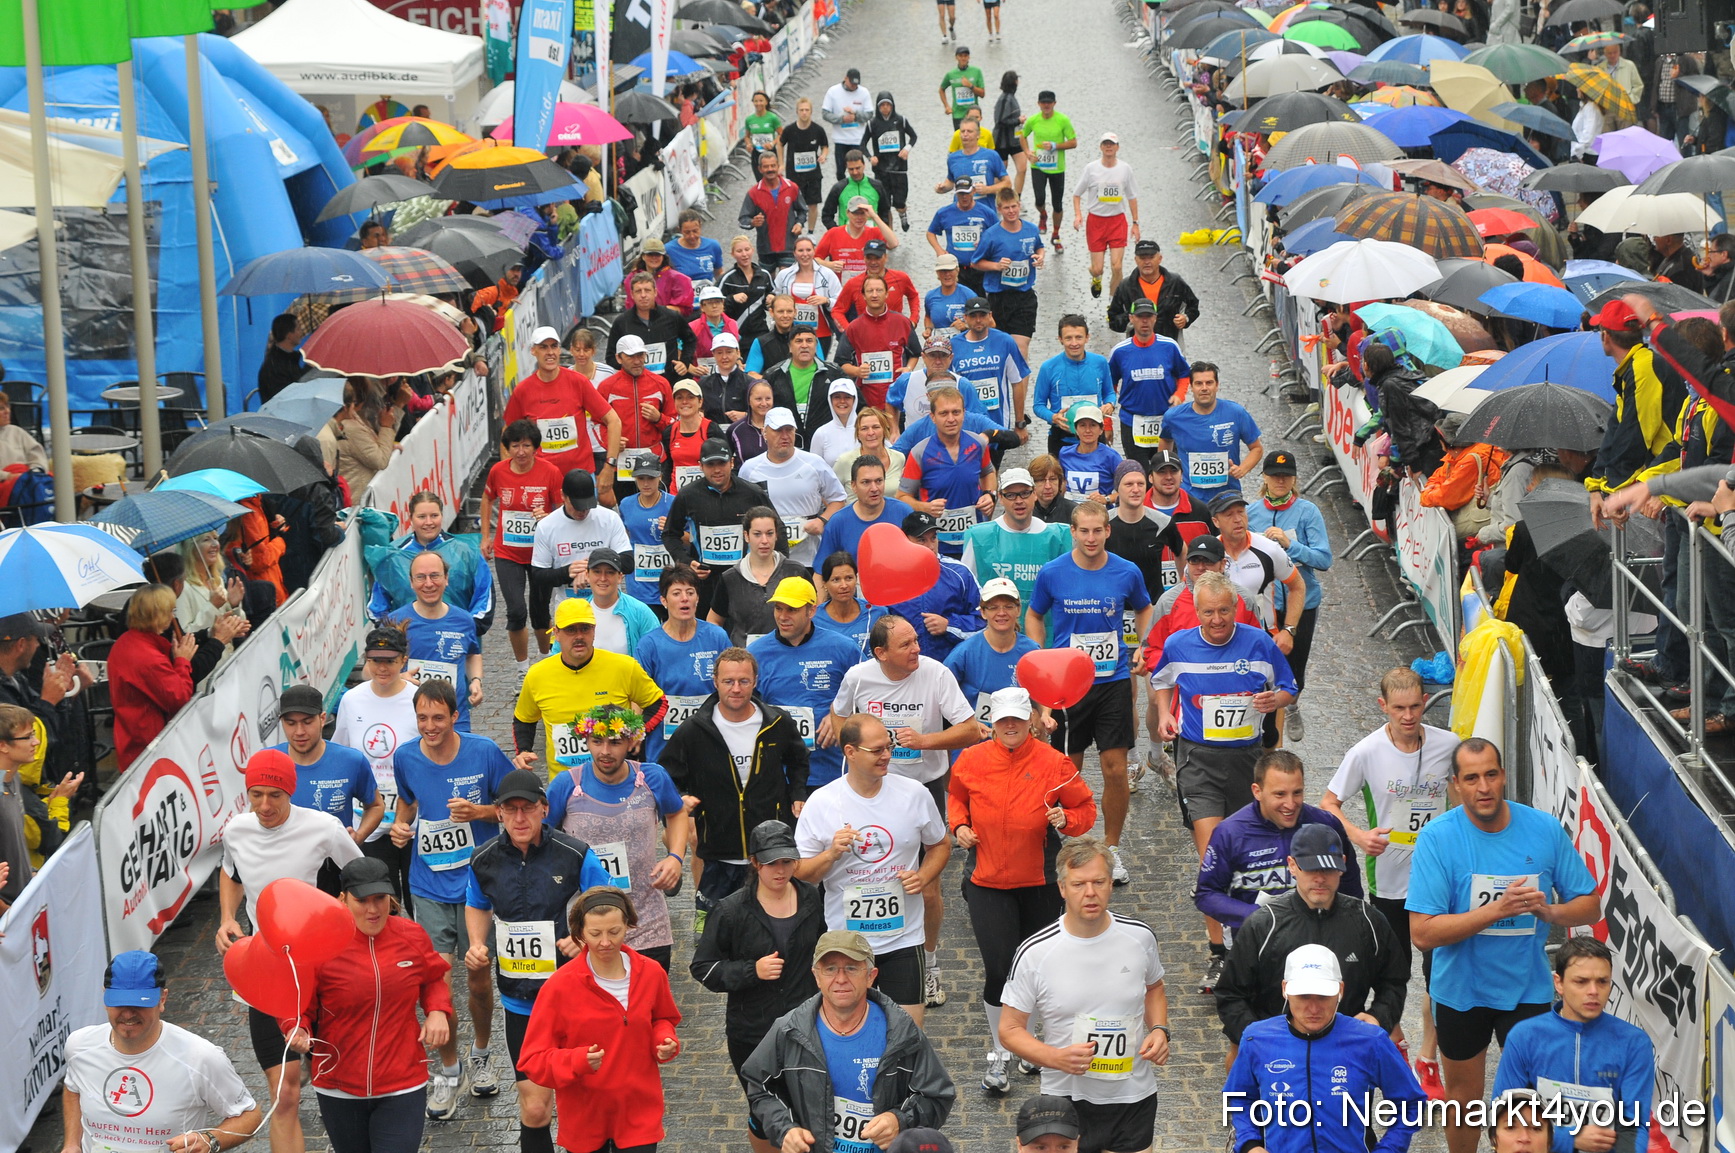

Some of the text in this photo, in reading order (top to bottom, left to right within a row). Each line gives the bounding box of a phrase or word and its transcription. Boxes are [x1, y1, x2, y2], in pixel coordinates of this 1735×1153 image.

[1103, 187, 1119, 197] 805
[954, 231, 978, 242] 3359
[1006, 266, 1028, 278] 2010
[796, 310, 816, 321] 878
[863, 359, 891, 373] 879
[959, 355, 1001, 369] SYSCAD
[1131, 367, 1165, 378] HUBER
[546, 426, 570, 441] 496
[1141, 423, 1160, 436] 149
[1192, 461, 1225, 475] 2953
[940, 516, 973, 532] 2205
[571, 540, 604, 551] Egner
[705, 536, 739, 551] 2957
[638, 554, 671, 568] 2760
[883, 702, 924, 713] Egner
[1215, 709, 1248, 727] 677
[421, 828, 468, 853] 3430
[850, 896, 899, 919] 2736
[859, 921, 892, 930] Andreas
[506, 938, 541, 958] 416
[512, 962, 536, 971] Alfred
[1087, 1033, 1127, 1057] 570
[87, 1118, 172, 1136] LAUFEN MIT HERZ
[105, 1134, 120, 1142] Heck
